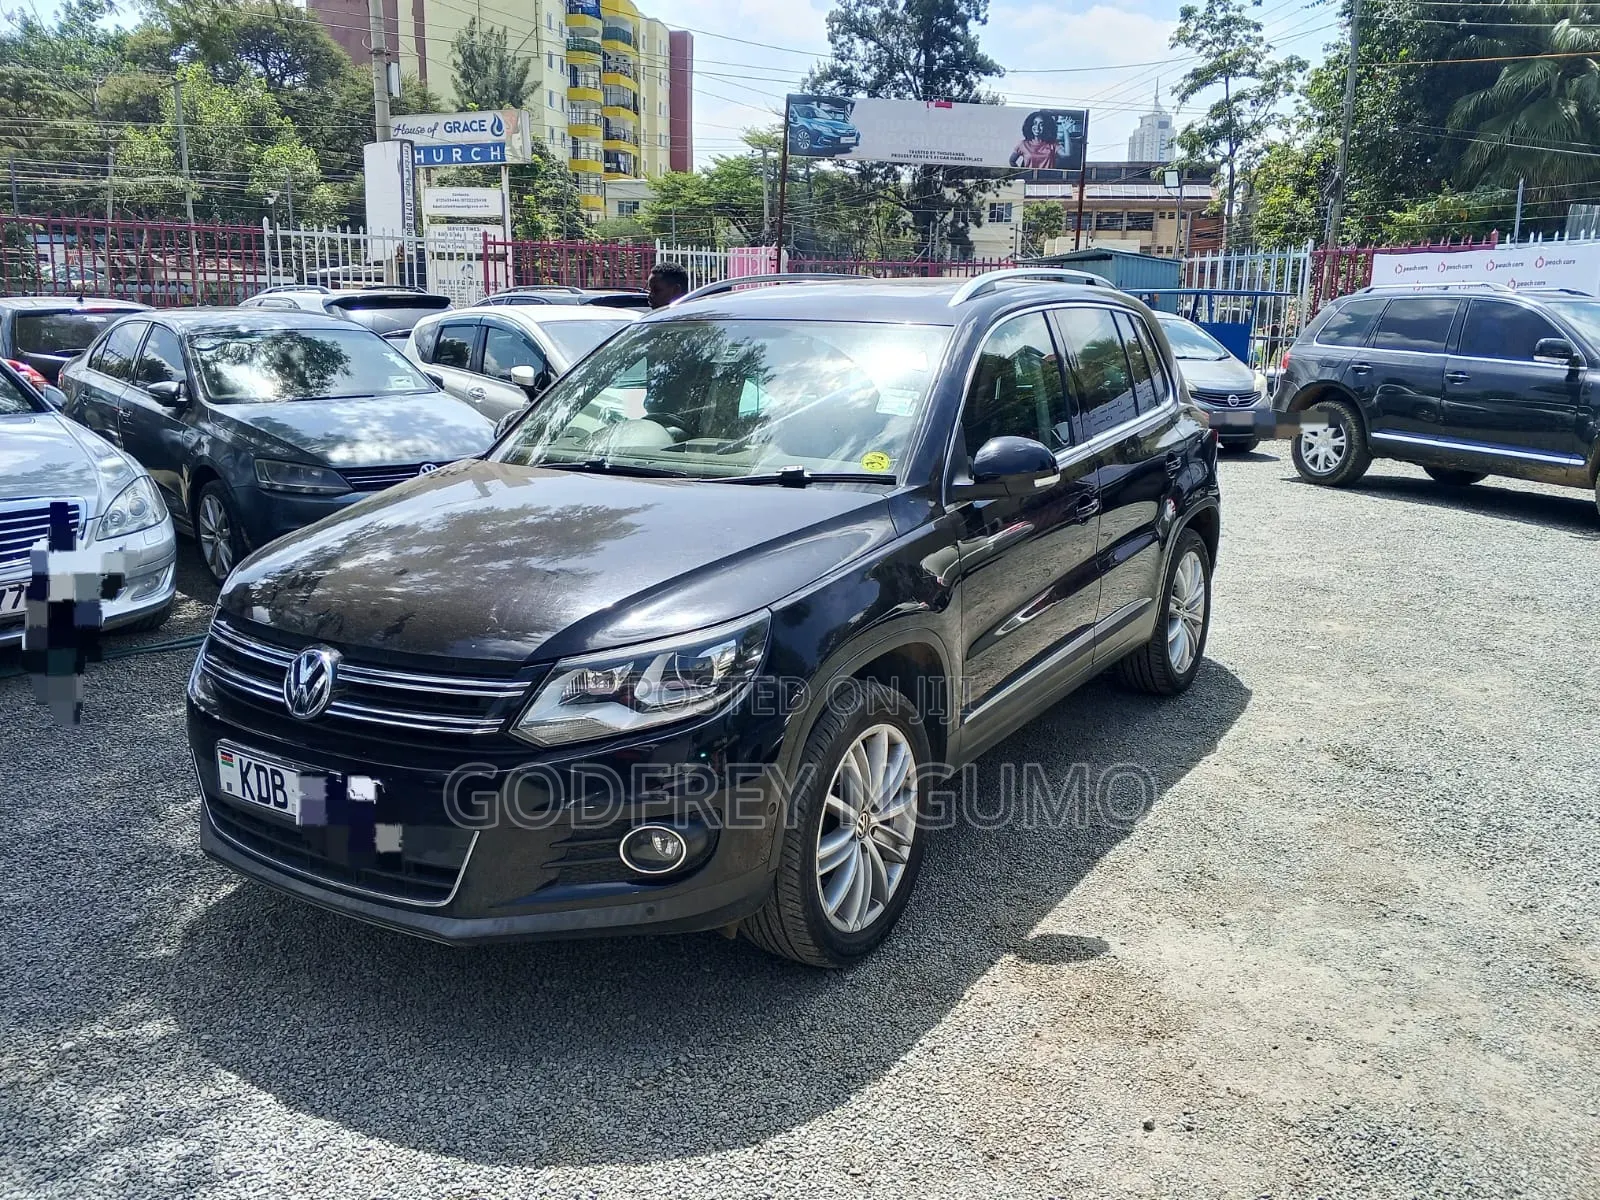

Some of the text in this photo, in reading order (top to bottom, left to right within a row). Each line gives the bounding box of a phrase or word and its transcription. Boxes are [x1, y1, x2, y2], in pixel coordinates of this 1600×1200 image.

[393, 119, 487, 138] House of GRACE
[414, 146, 501, 163] HURCH
[1403, 264, 1417, 272] peach
[1517, 280, 1533, 288] peach
[239, 758, 288, 809] KDB
